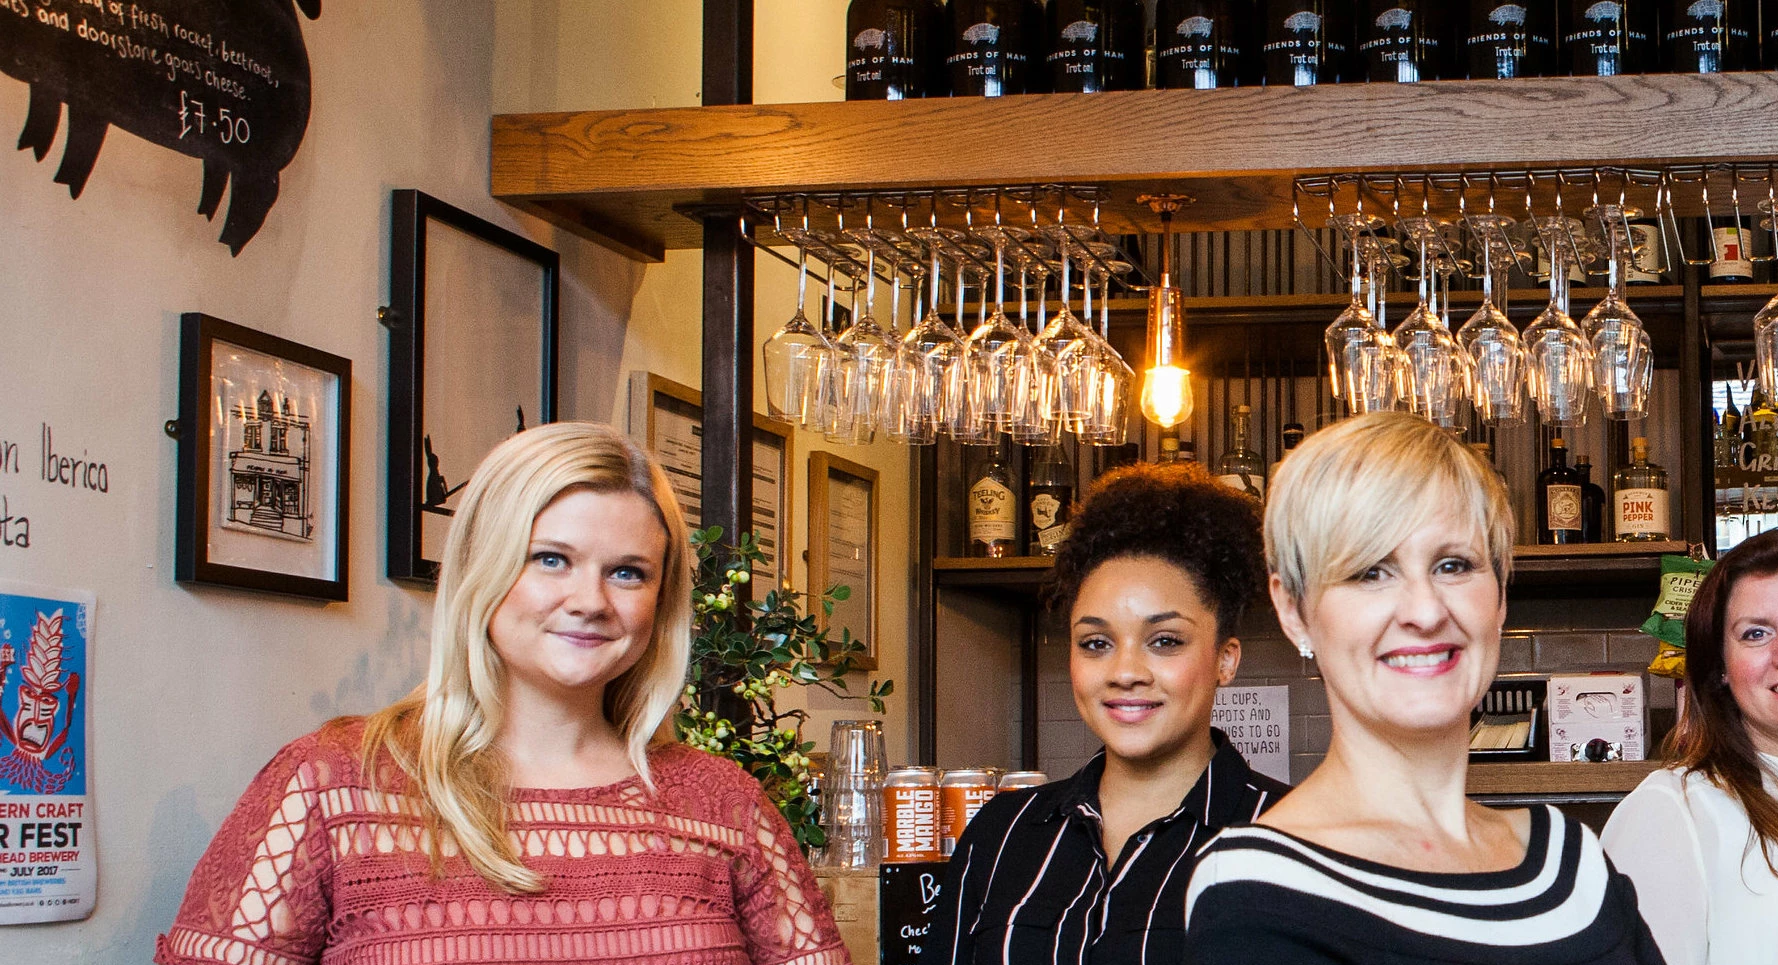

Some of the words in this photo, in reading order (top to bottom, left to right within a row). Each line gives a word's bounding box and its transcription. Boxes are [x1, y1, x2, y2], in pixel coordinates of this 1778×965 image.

[37, 6, 70, 32] and
[131, 6, 169, 38] fresh
[1468, 33, 1506, 46] FRIENDS
[1514, 33, 1526, 41] OF
[1532, 35, 1549, 44] HAM
[1566, 30, 1602, 42] FRIENDS
[1629, 31, 1647, 40] HAM
[1667, 27, 1704, 40] FRIENDS
[1711, 26, 1724, 34] OF
[1264, 40, 1301, 52] FRIENDS
[1308, 40, 1321, 48] OF
[1328, 42, 1346, 52] HAM
[1398, 36, 1411, 44] OF
[1419, 38, 1438, 46] HAM
[986, 51, 999, 59] OF
[1084, 49, 1096, 57] OF
[1200, 44, 1213, 52] OF
[1220, 46, 1240, 55] HAM
[872, 56, 885, 64] OF
[892, 55, 914, 65] HAM
[179, 90, 250, 145] £7.50
[42, 421, 109, 494] Iberico
[972, 489, 1005, 501] TEELING
[1623, 501, 1654, 514] PINK
[1623, 514, 1654, 522] PEPPER
[1216, 694, 1227, 706] LL
[1212, 710, 1245, 722] APOTS
[1250, 708, 1271, 720] AND
[1249, 725, 1262, 738] TO
[1266, 724, 1280, 738] GO
[36, 802, 84, 818] CRAFT
[896, 790, 915, 852] MARBLE
[915, 790, 934, 852] MANGO
[20, 822, 82, 848] FEST
[0, 852, 26, 864] EAD
[29, 850, 80, 863] BREWERY
[10, 866, 34, 877] JULY
[37, 866, 58, 876] 2017
[900, 922, 931, 939] Chec
